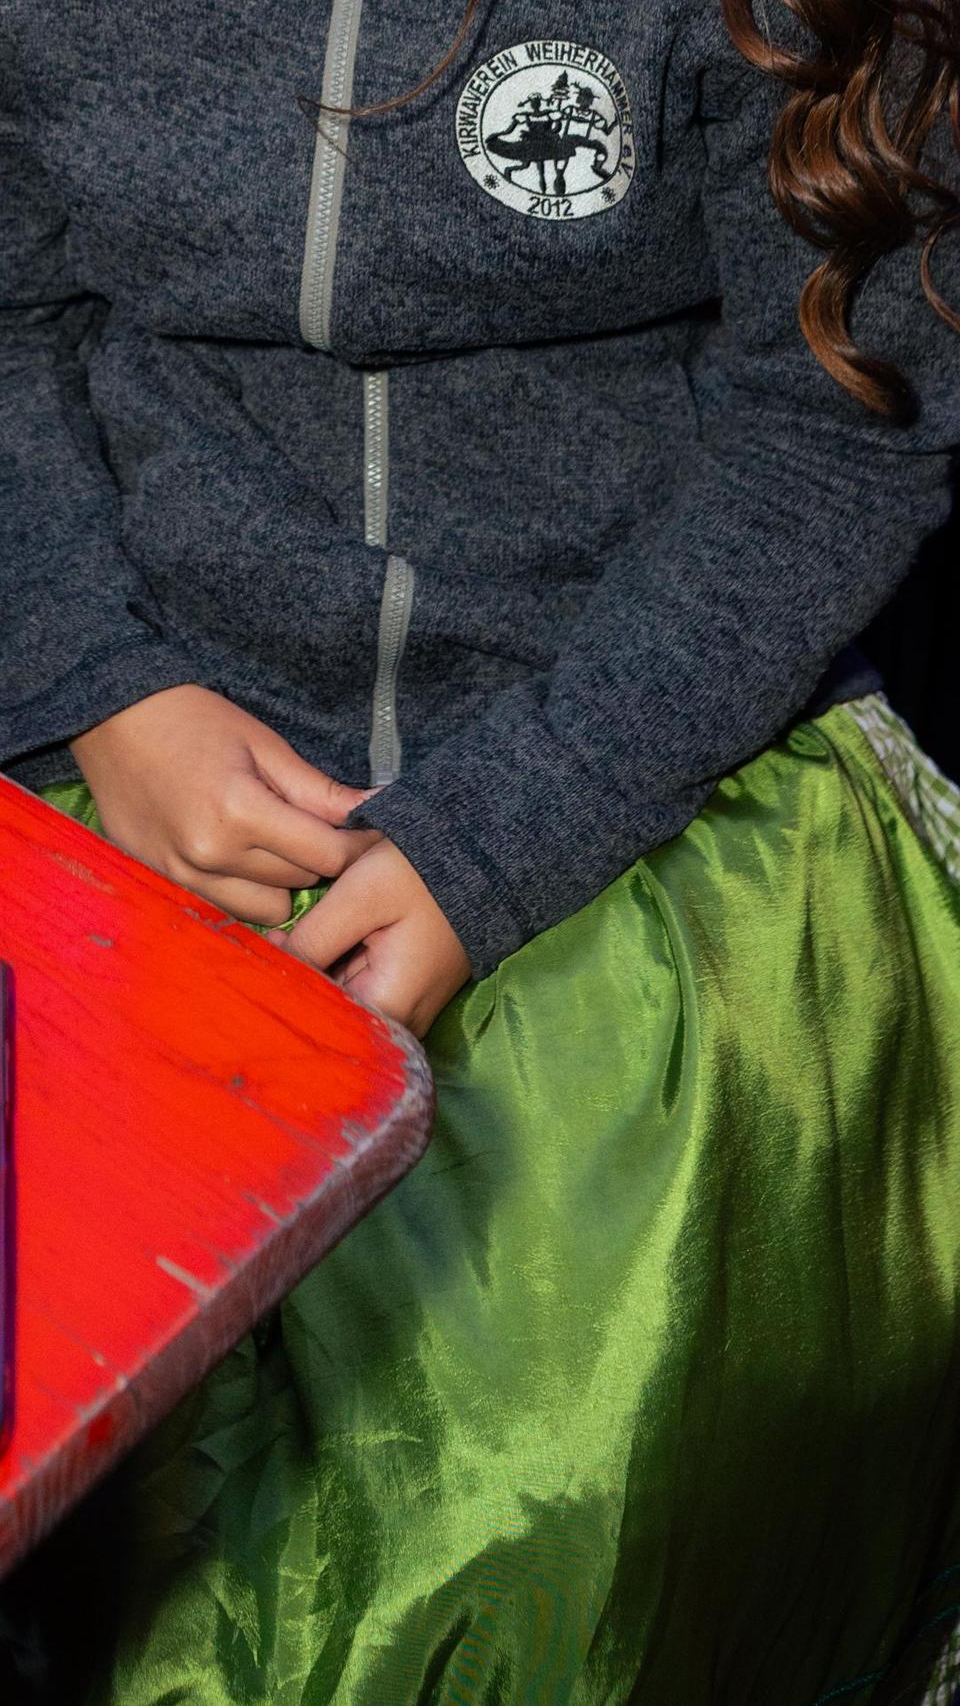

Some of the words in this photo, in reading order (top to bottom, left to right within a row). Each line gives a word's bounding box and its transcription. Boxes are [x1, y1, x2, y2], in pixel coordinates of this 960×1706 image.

[459, 51, 517, 160] KIRWAVEREIN
[524, 42, 634, 134] WEIHERHAMMER
[527, 195, 575, 217] 2012
